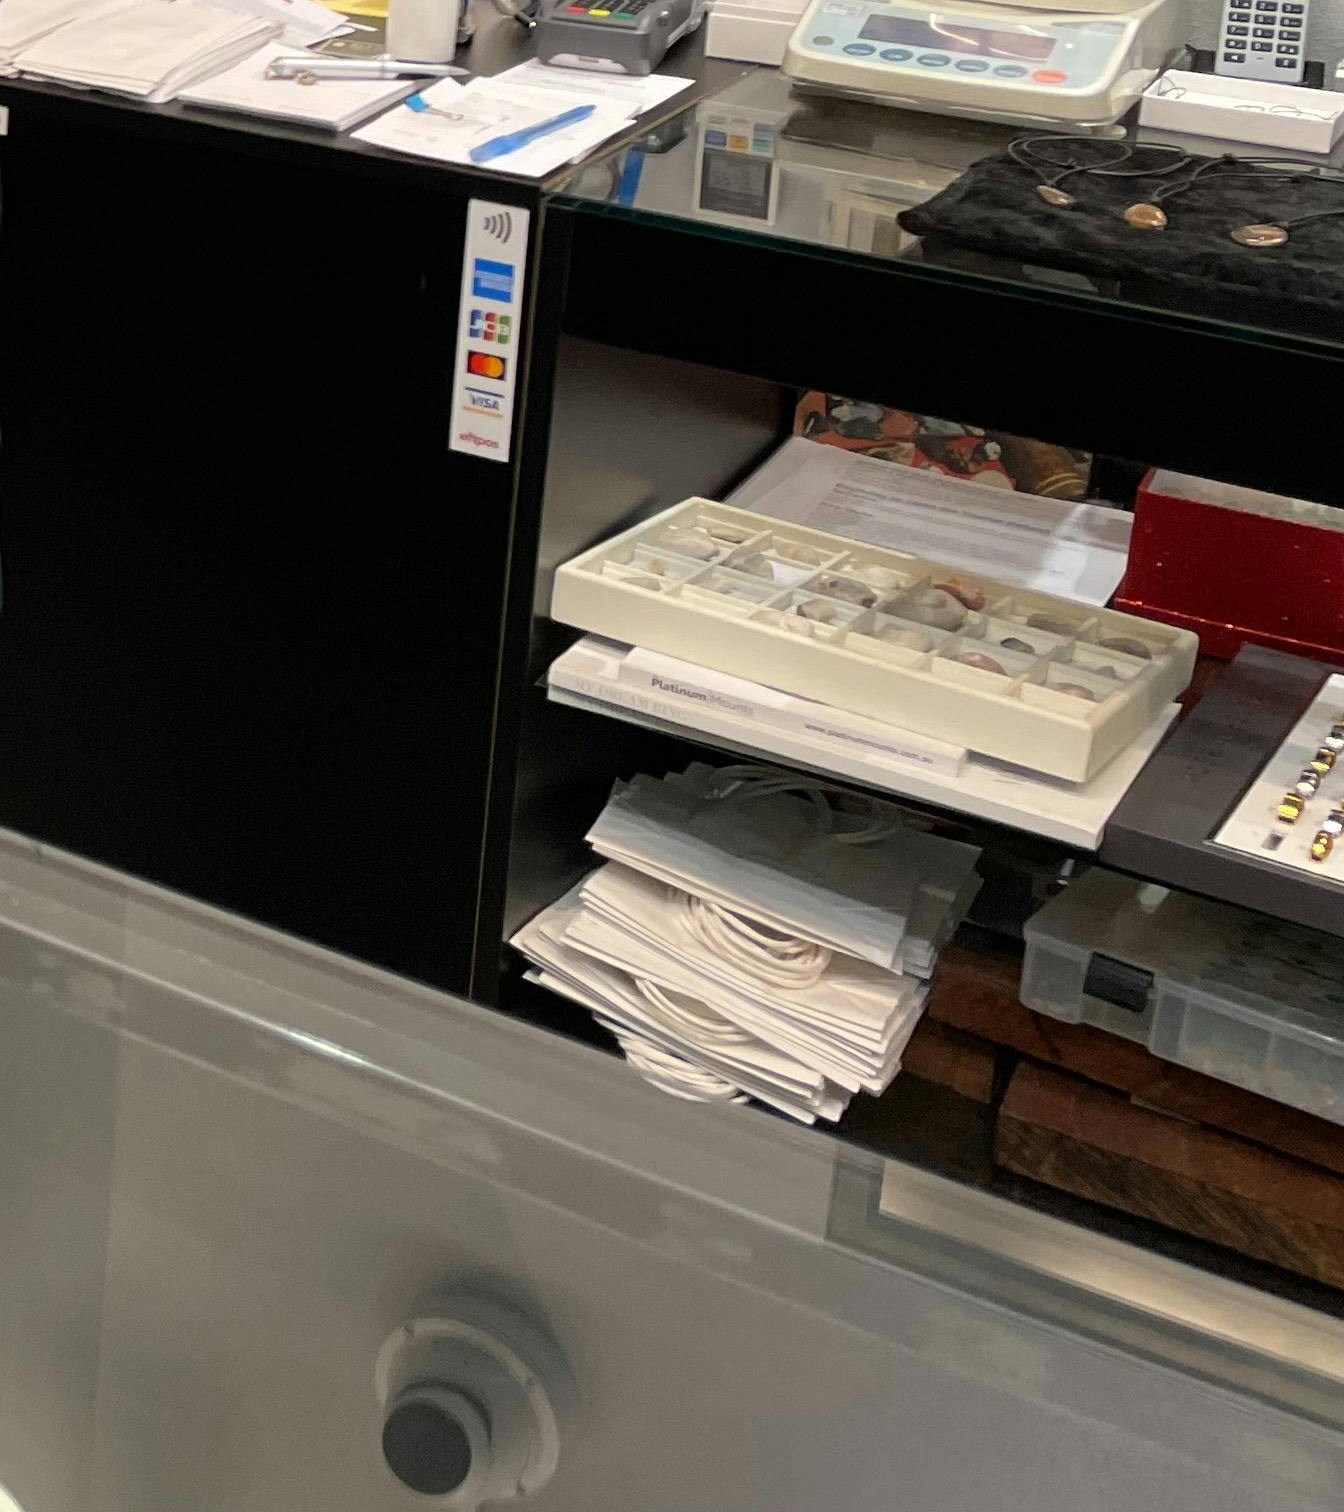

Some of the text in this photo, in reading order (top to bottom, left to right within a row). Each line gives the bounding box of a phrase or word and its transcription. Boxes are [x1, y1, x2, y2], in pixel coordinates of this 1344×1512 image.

[470, 394, 500, 411] VISA
[651, 675, 755, 716] Platinum Mounts
